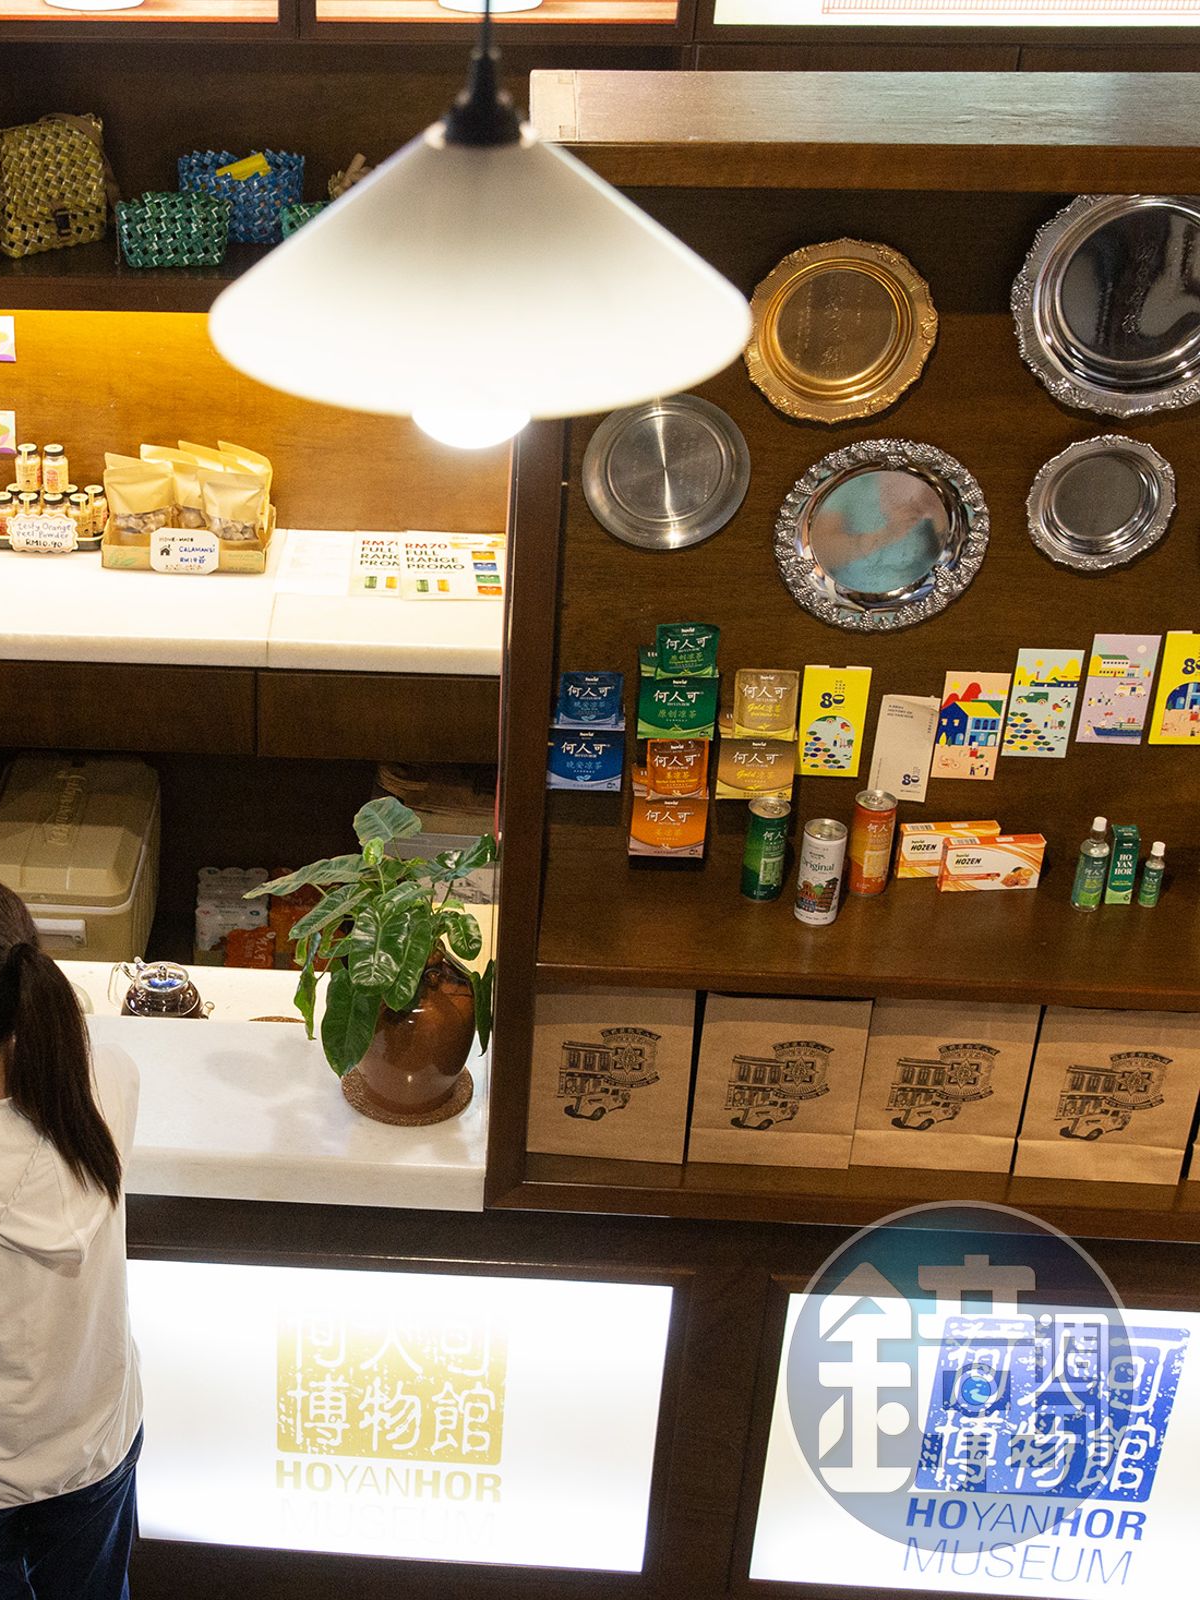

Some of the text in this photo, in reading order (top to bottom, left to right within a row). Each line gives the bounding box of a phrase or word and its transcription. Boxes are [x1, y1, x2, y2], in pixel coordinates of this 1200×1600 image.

[665, 635, 707, 651] 何人可
[567, 684, 612, 698] 何人可
[653, 689, 701, 704] 何人可
[742, 684, 788, 699] 何人可
[820, 692, 846, 709] 80
[561, 741, 609, 755] 何人可
[654, 753, 697, 768] 何人可
[732, 751, 780, 765] 何人可
[902, 773, 920, 786] 80
[645, 809, 692, 824] 何人可
[910, 844, 938, 852] HOZEN
[955, 858, 982, 866] HOZEN
[286, 1371, 497, 1456] 博物館
[933, 1410, 1156, 1493] 博物館
[275, 1458, 503, 1503] HOYANHOR
[905, 1497, 1148, 1542] HOYANHOR
[903, 1536, 1133, 1587] MUSEUM
